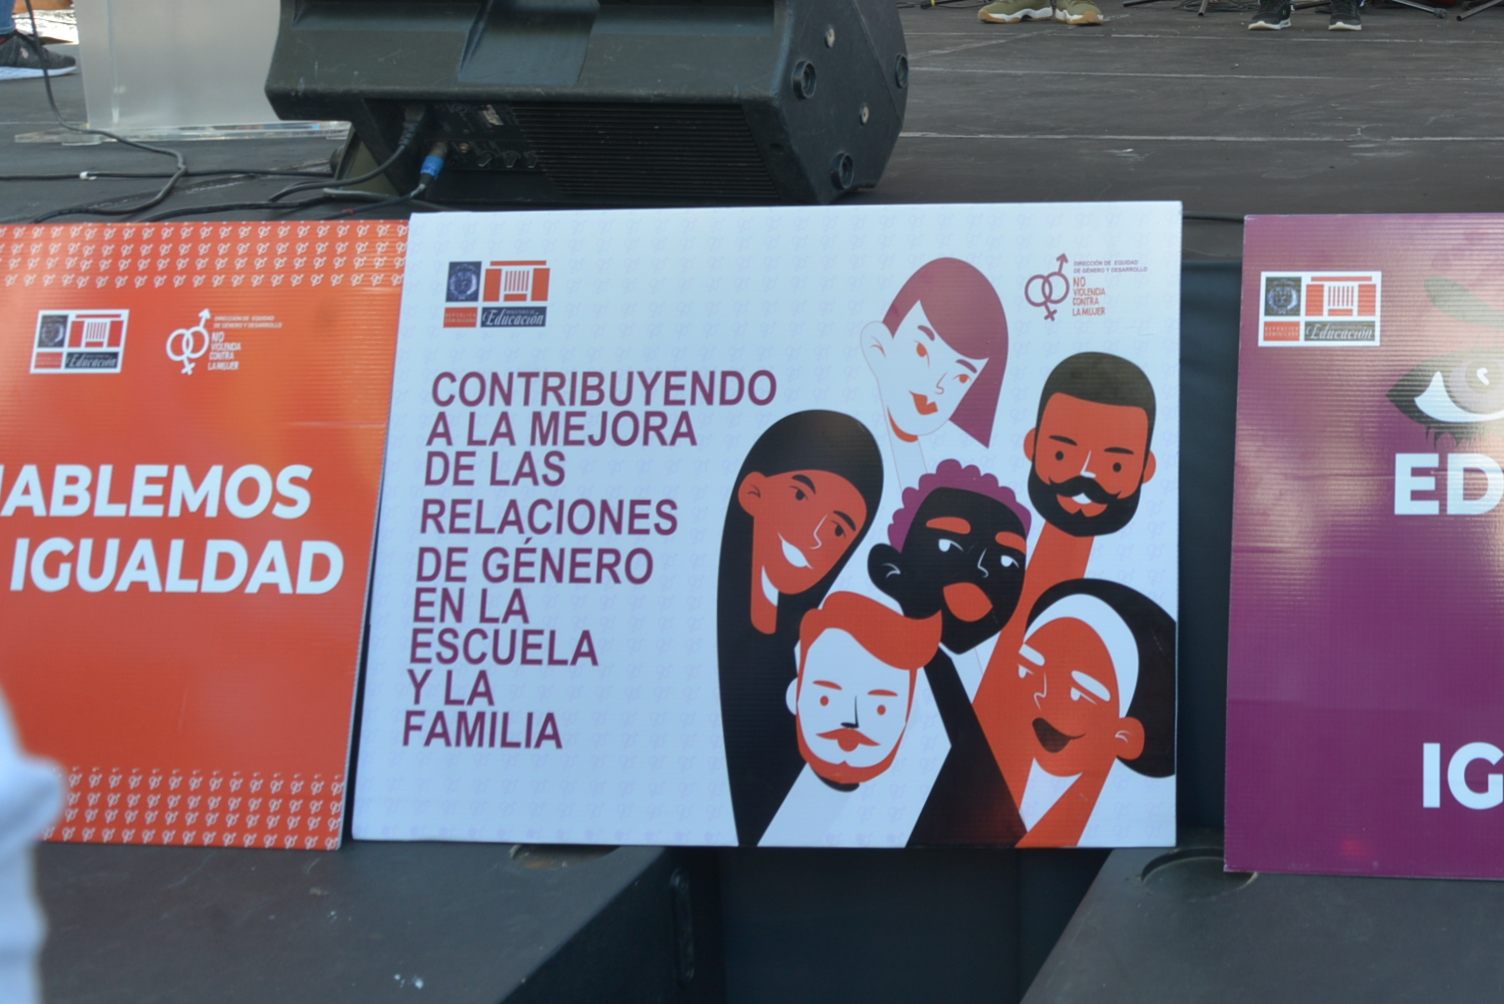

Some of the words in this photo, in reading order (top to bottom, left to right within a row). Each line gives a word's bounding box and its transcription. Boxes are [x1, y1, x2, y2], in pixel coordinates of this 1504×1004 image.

[482, 308, 544, 326] Educación
[1306, 323, 1373, 340] Educación
[432, 369, 778, 407] CONTRIBUYENDO
[426, 411, 454, 446] A
[466, 411, 516, 446] LA
[529, 410, 698, 447] MEJORA
[424, 451, 477, 487] DE
[489, 450, 566, 487] LAS
[0, 464, 313, 519] ABLEMOS
[420, 498, 678, 536] RELACIONES
[9, 537, 345, 595] IGUALDAD
[415, 546, 469, 583] DE
[481, 537, 654, 585] GÉNERO
[412, 587, 465, 623] EN
[479, 588, 530, 624] LA
[409, 628, 599, 666] ESCUELA
[407, 668, 433, 706] Y
[444, 669, 495, 707] LA
[402, 710, 563, 749] FAMILIA
